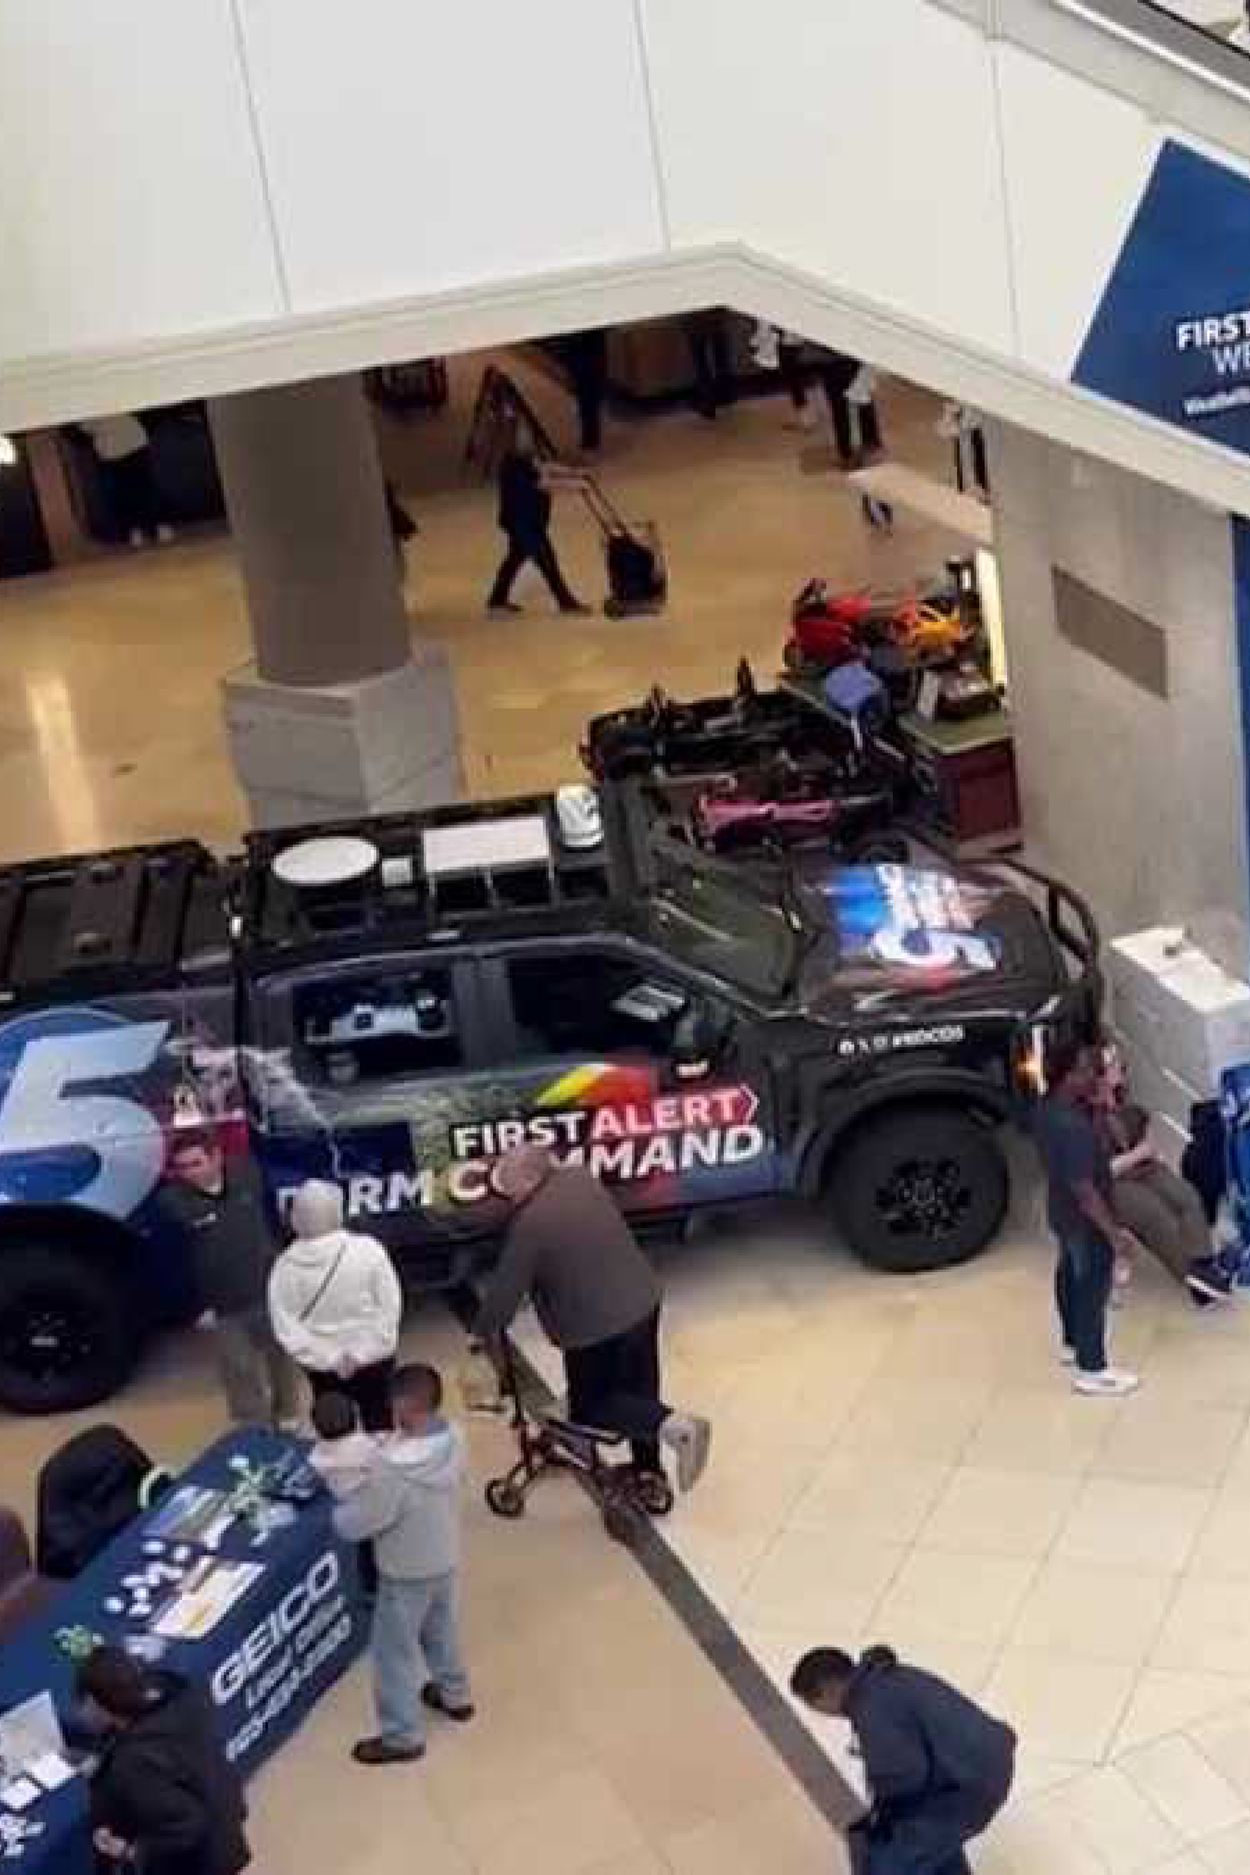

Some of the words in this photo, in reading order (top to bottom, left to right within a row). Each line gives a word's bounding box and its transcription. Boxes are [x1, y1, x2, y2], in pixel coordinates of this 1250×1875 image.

[0, 1020, 171, 1219] 5
[447, 1124, 764, 1202] CMAND
[453, 1111, 587, 1157] FIRST
[591, 1088, 742, 1138] ALERT
[211, 1552, 339, 1706] GEICO
